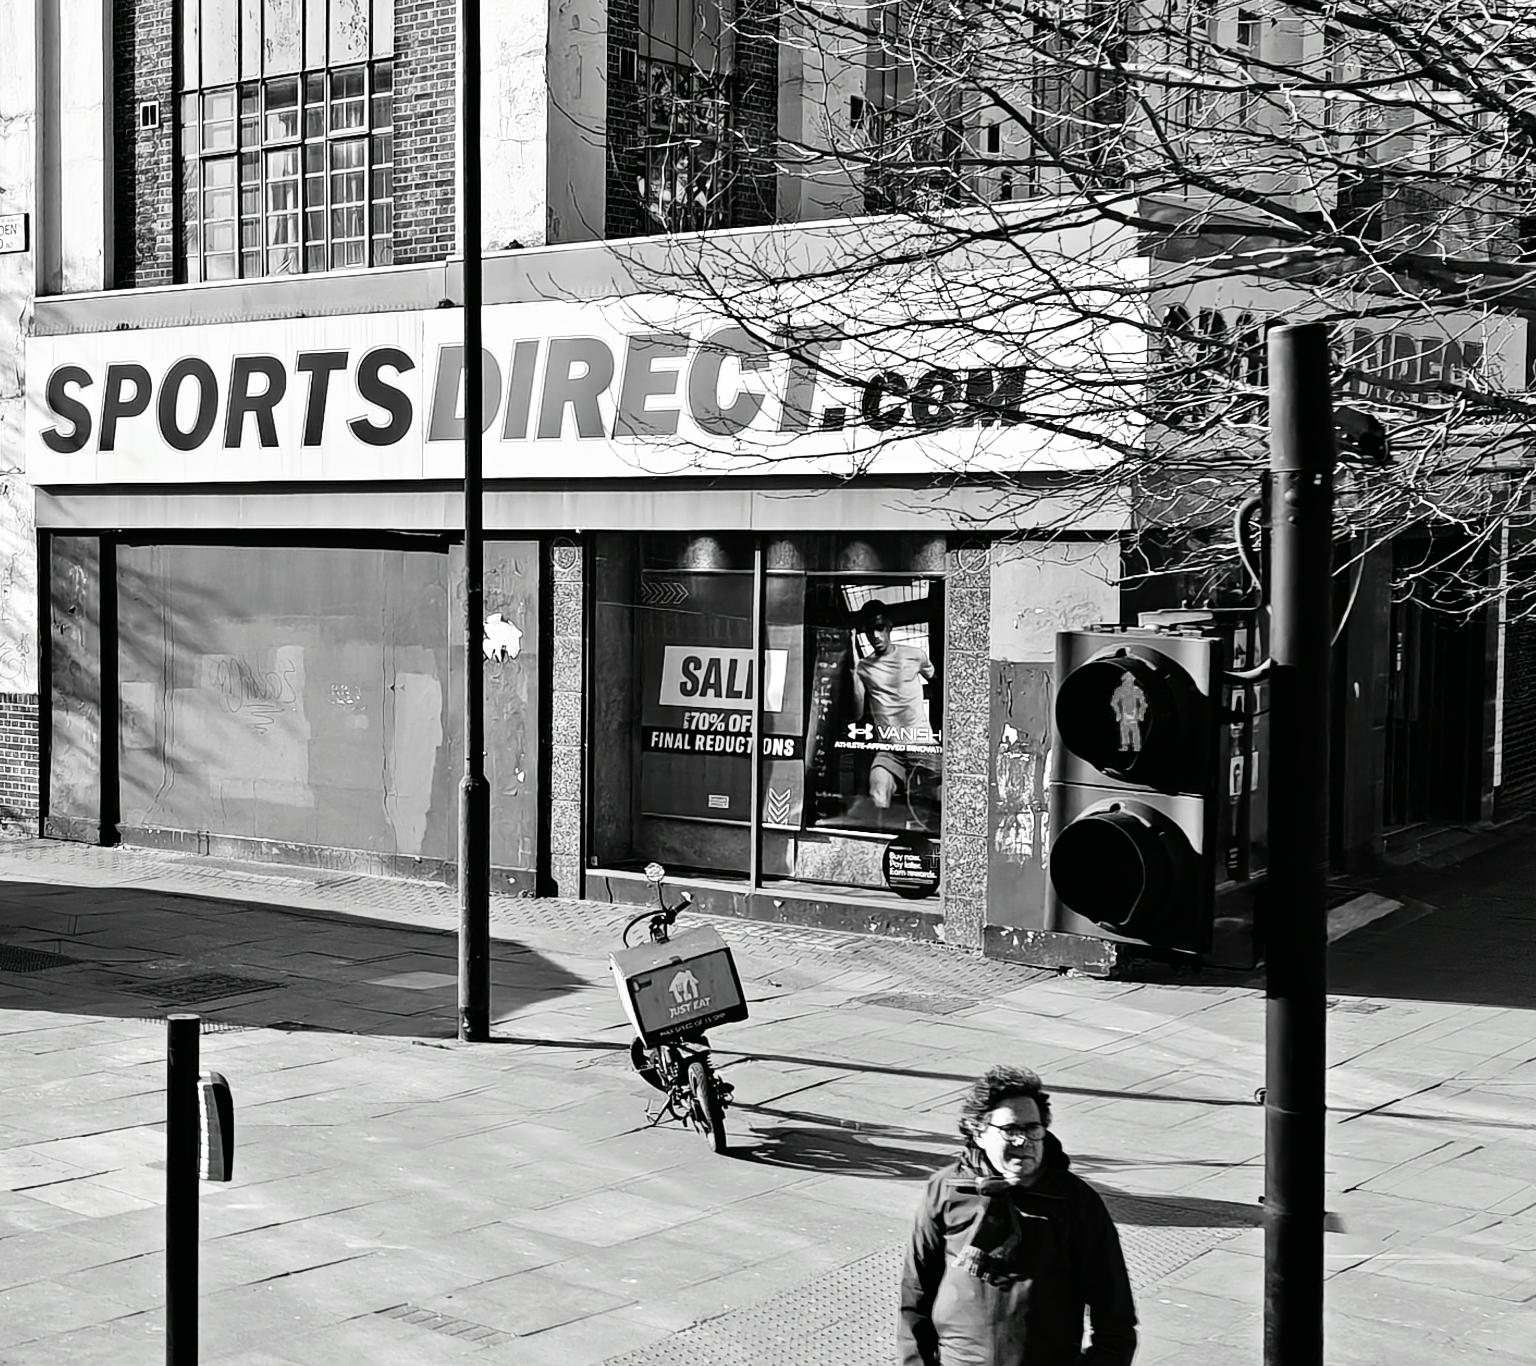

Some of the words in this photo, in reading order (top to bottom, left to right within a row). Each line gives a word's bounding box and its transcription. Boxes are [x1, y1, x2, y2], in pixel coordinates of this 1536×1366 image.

[679, 655, 753, 700] SAL
[690, 711, 726, 732] 70%
[728, 713, 753, 733] OF
[877, 725, 942, 742] VANISH
[650, 731, 692, 750] FINAL
[694, 733, 795, 757] REDUCTONS
[668, 1001, 693, 1019] JUST
[693, 996, 712, 1011] EAT
